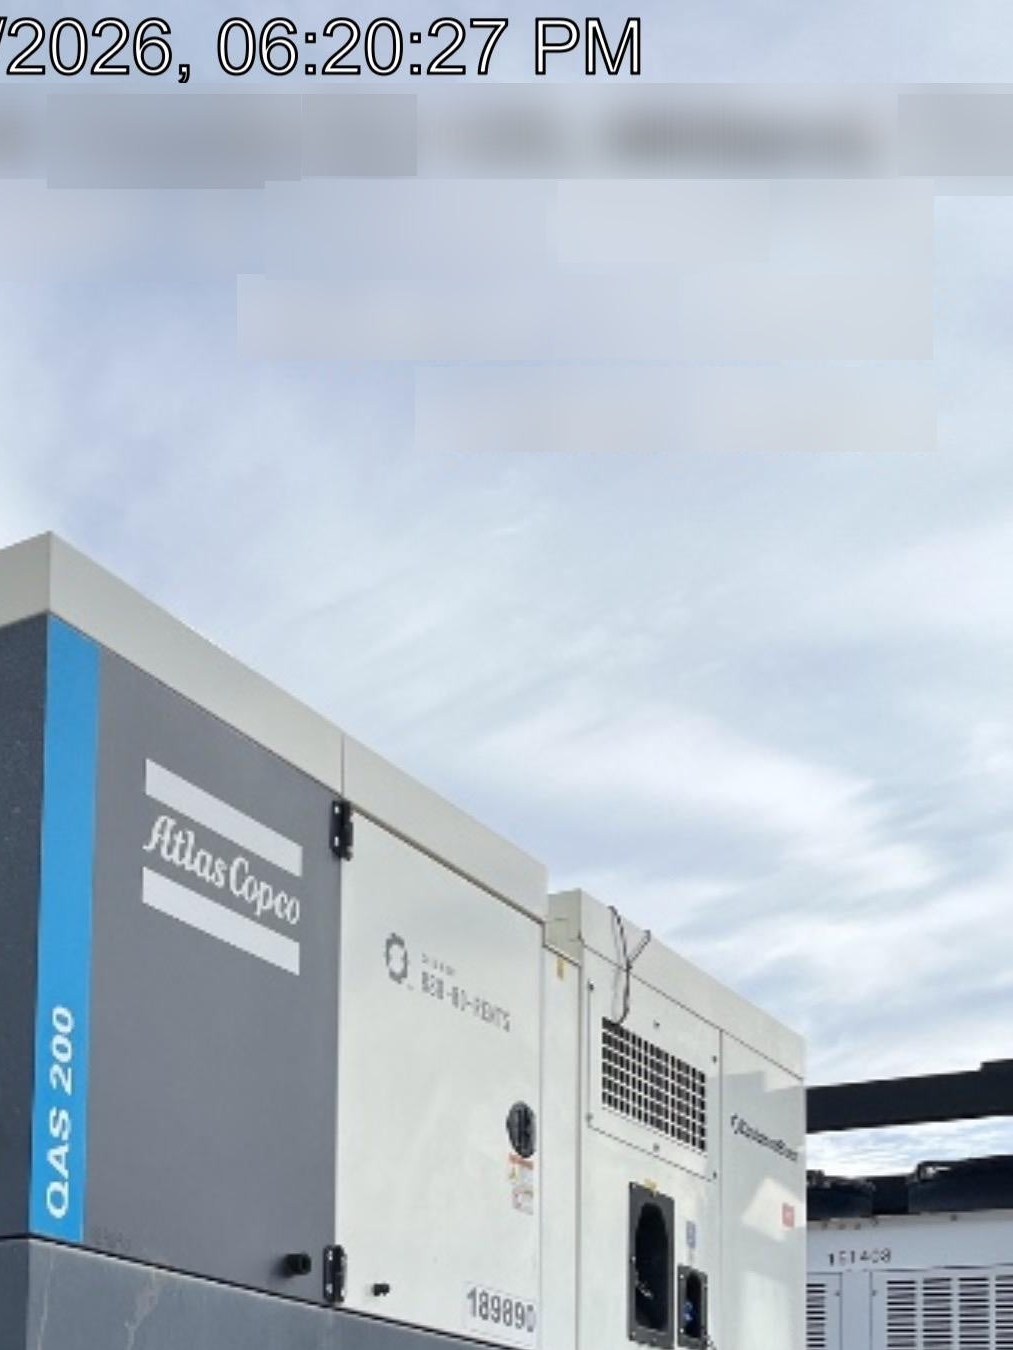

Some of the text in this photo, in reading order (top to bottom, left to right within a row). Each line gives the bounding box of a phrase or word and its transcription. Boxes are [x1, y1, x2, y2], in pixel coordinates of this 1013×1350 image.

[46, 1006, 76, 1219] QAS 200
[467, 1287, 537, 1333] 189890
